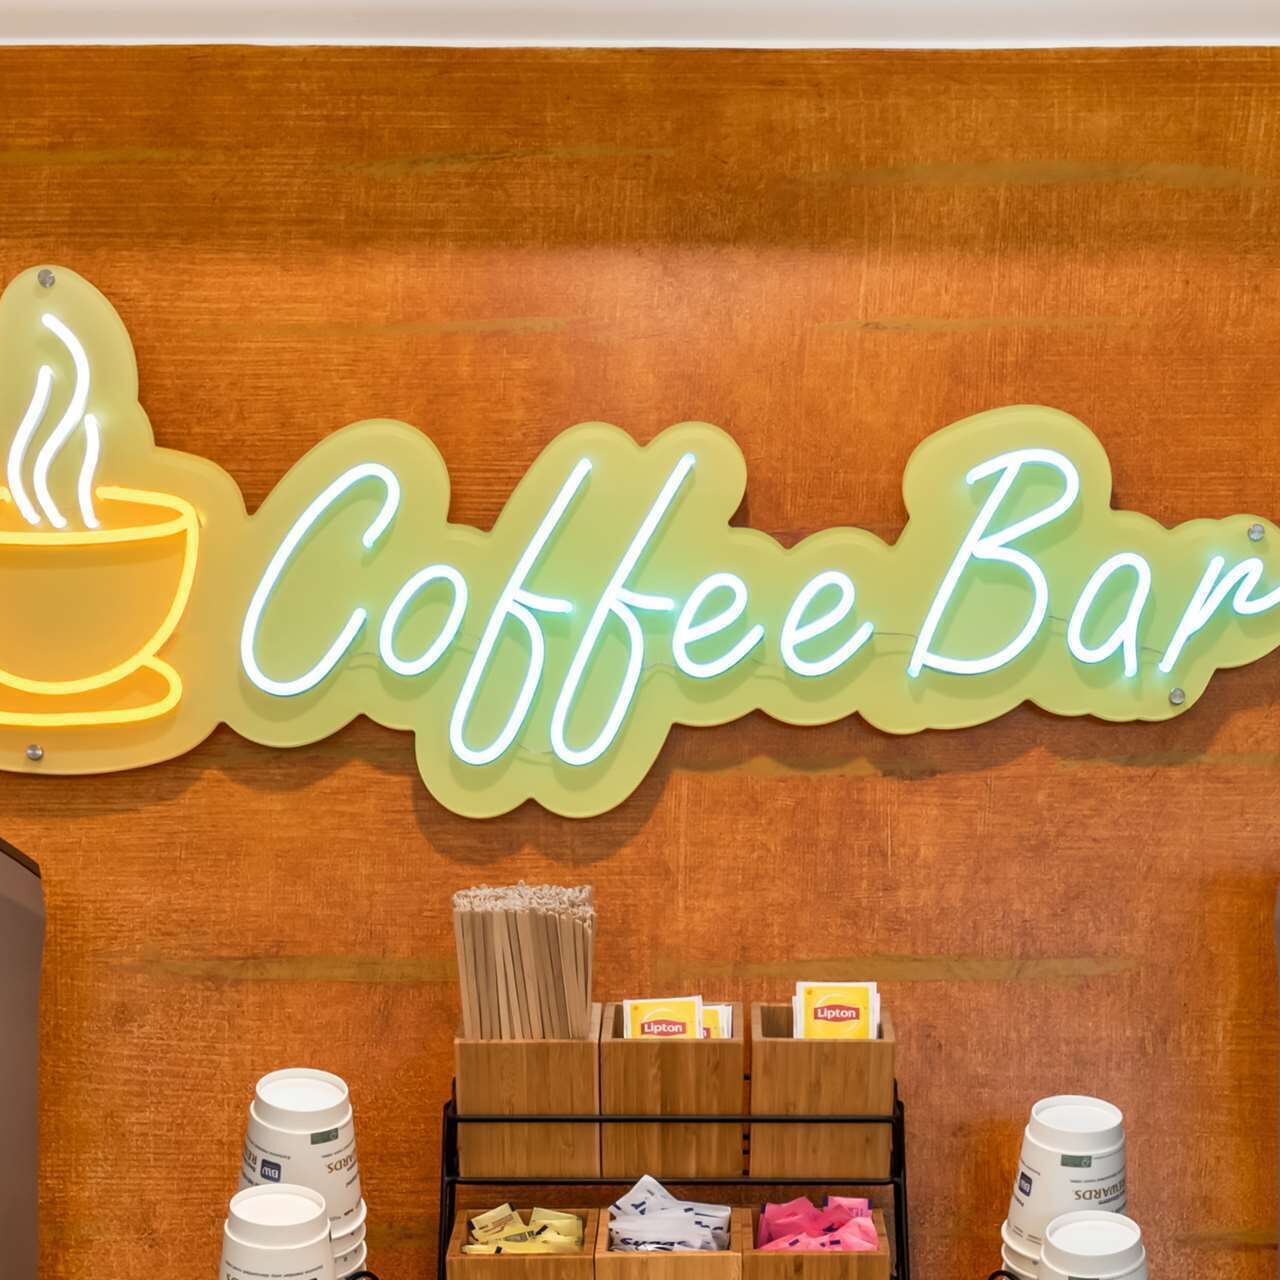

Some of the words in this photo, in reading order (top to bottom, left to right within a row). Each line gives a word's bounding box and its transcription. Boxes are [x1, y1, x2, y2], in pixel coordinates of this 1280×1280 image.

[240, 452, 875, 767] Coffee
[816, 1007, 856, 1021] Lipton
[644, 1023, 683, 1036] Lipton
